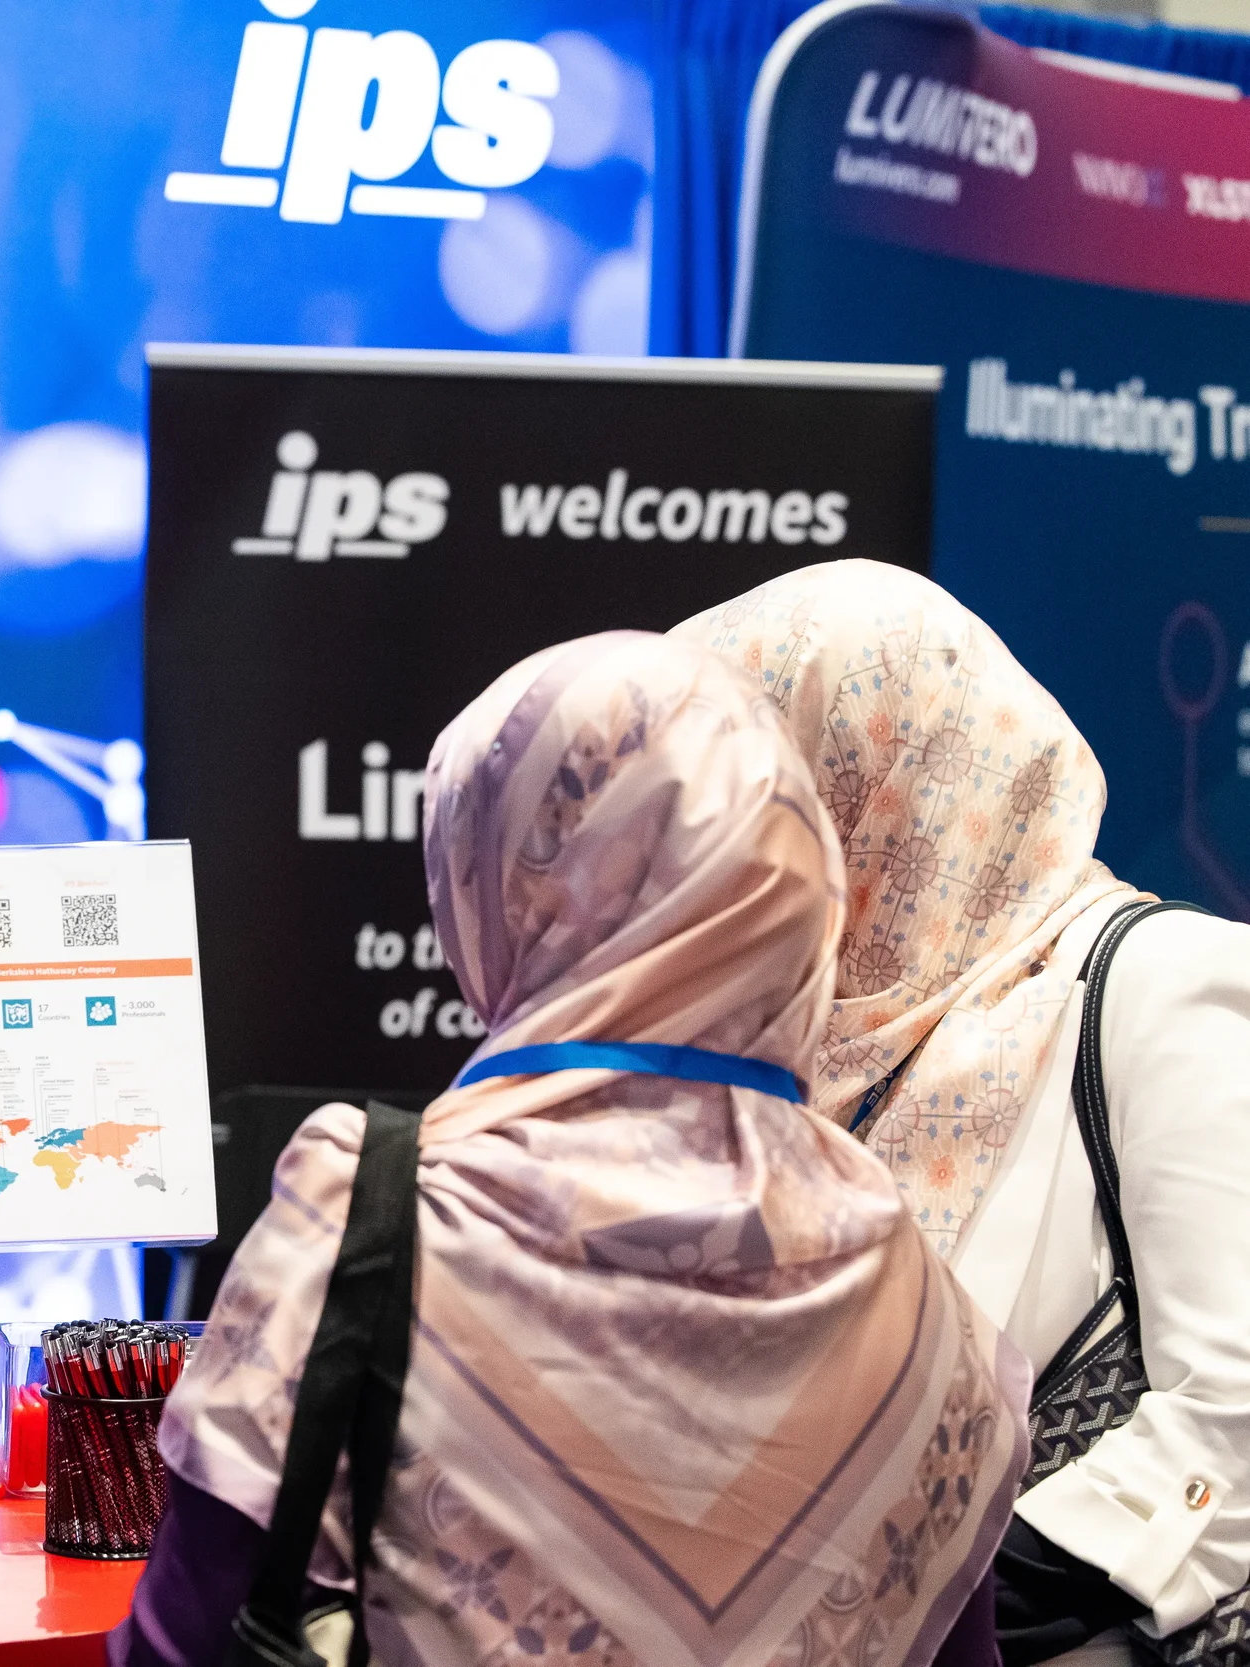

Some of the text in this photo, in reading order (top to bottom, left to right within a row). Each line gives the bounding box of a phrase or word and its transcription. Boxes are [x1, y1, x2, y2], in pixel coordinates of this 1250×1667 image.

[221, 0, 560, 224] ips
[263, 430, 848, 561] ips welcomes
[78, 966, 116, 974] Company
[354, 922, 406, 970] to
[38, 1004, 49, 1012] 17
[379, 986, 438, 1038] of
